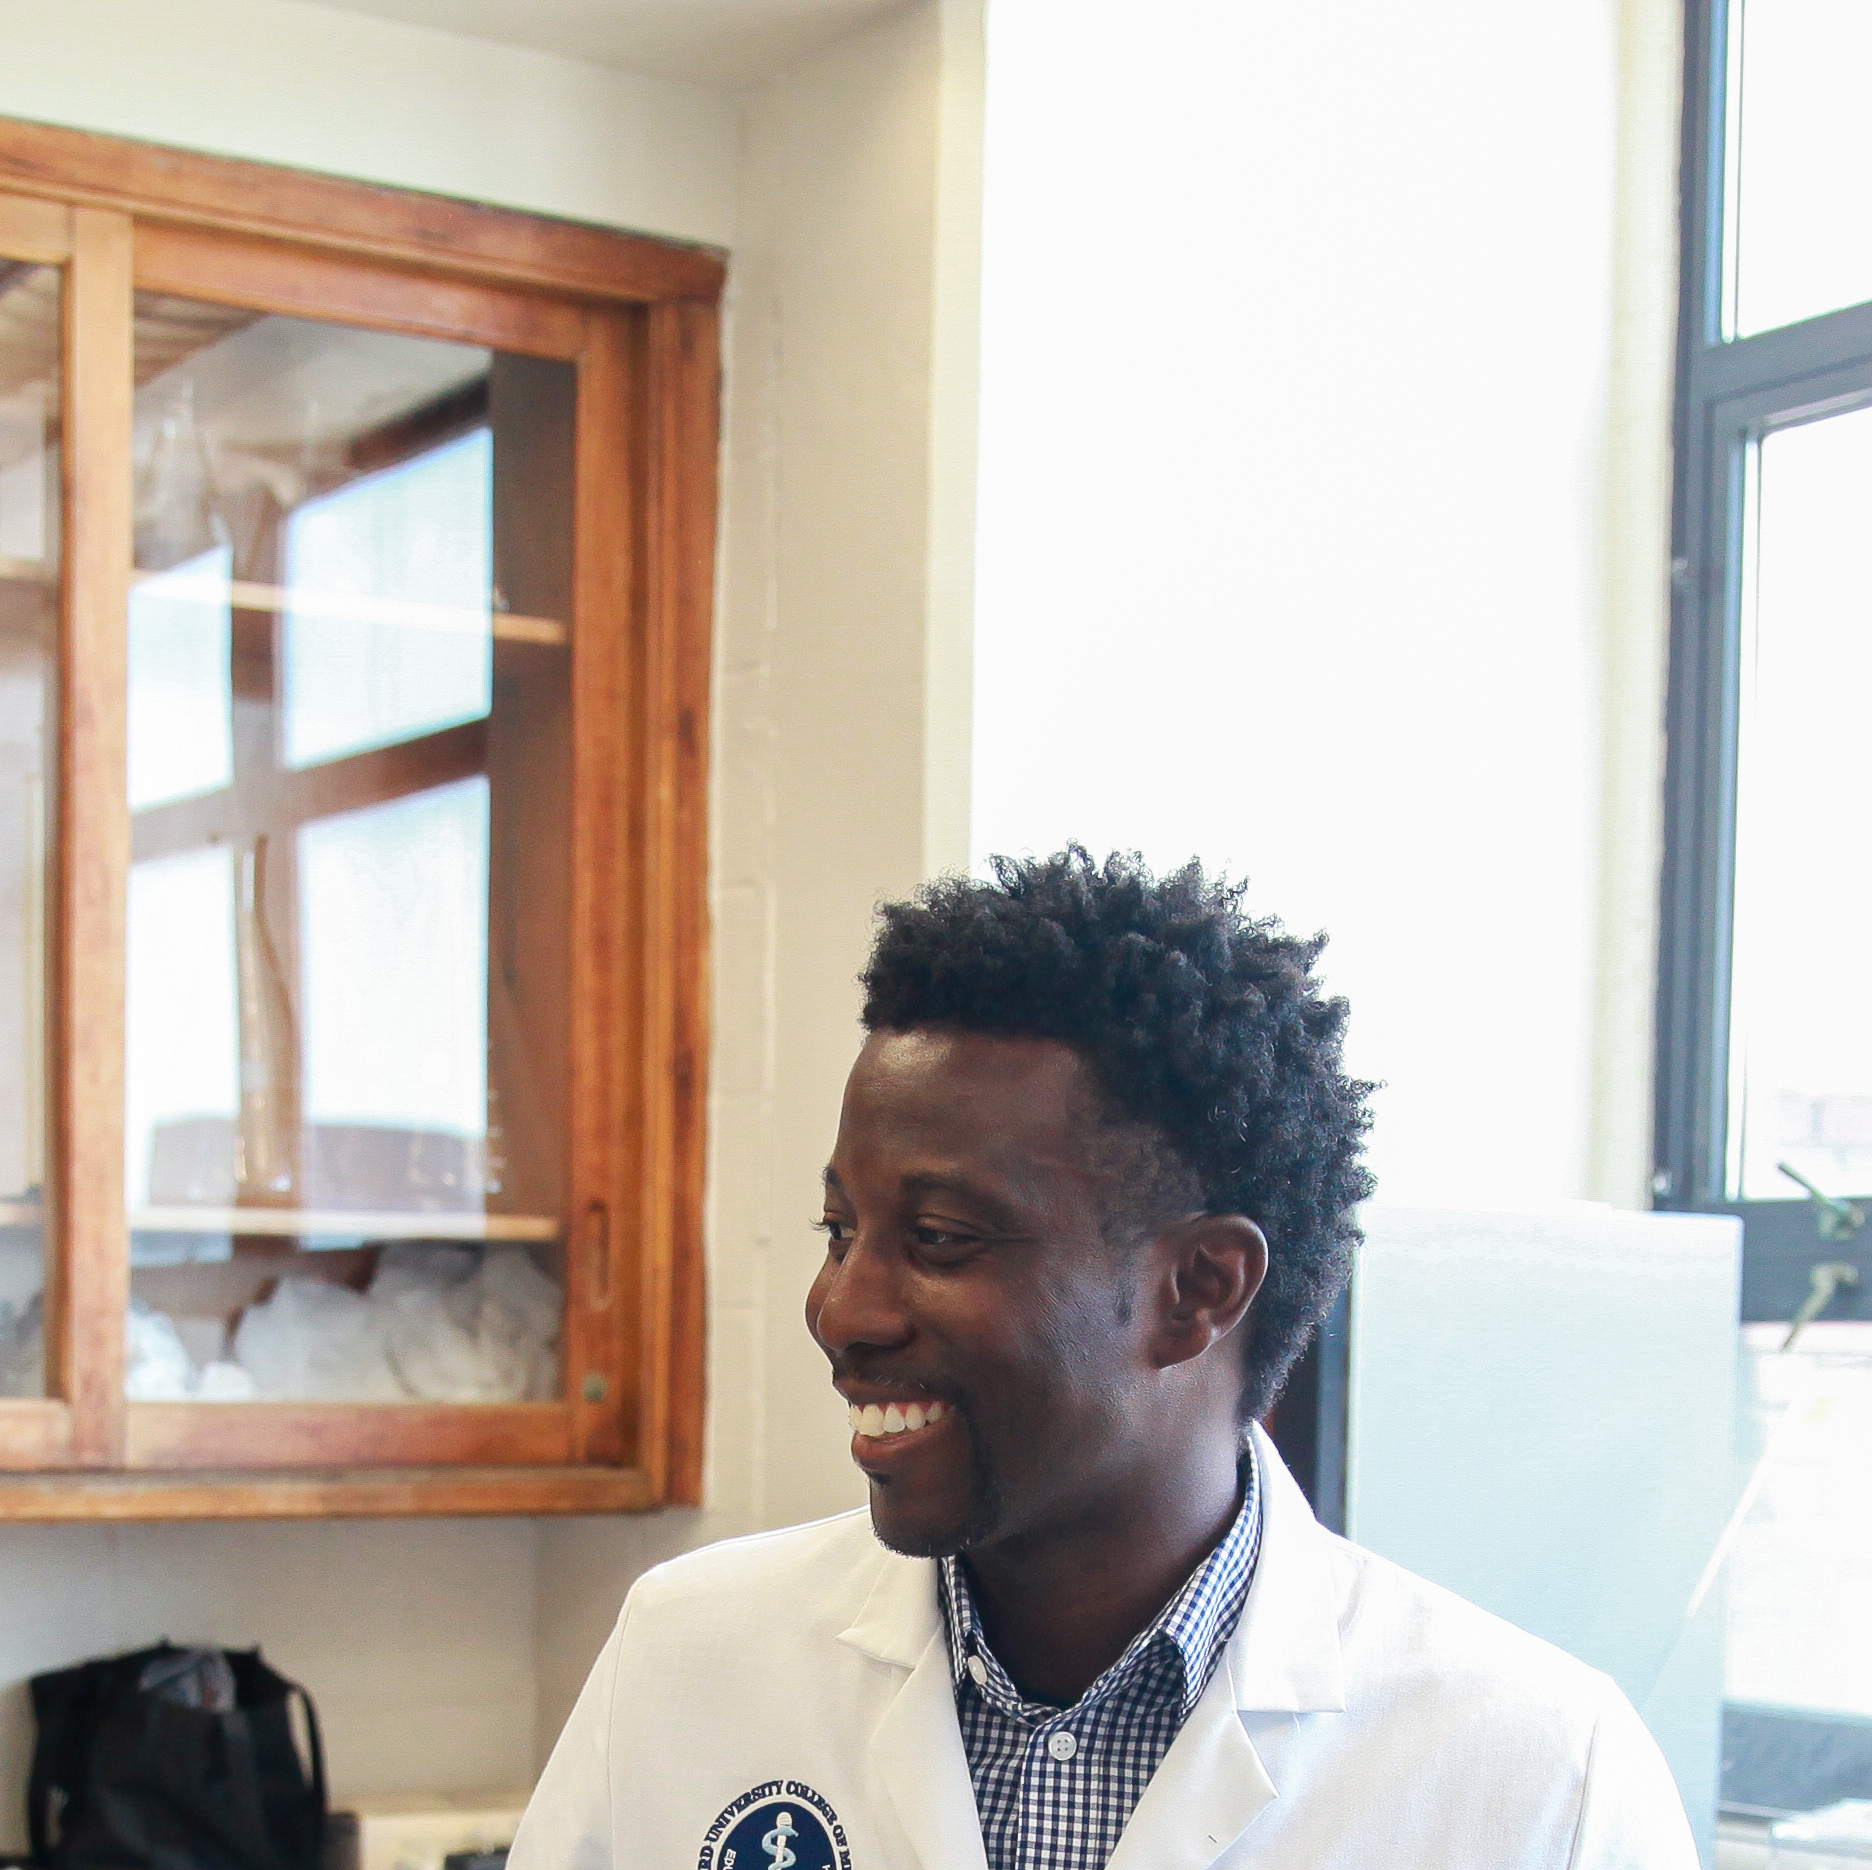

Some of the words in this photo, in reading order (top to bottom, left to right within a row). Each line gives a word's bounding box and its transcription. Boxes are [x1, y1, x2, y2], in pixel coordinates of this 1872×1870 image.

[704, 1780, 784, 1843] UNIVERSITY
[786, 1780, 838, 1826] COLLEGE
[832, 1824, 848, 1847] OF
